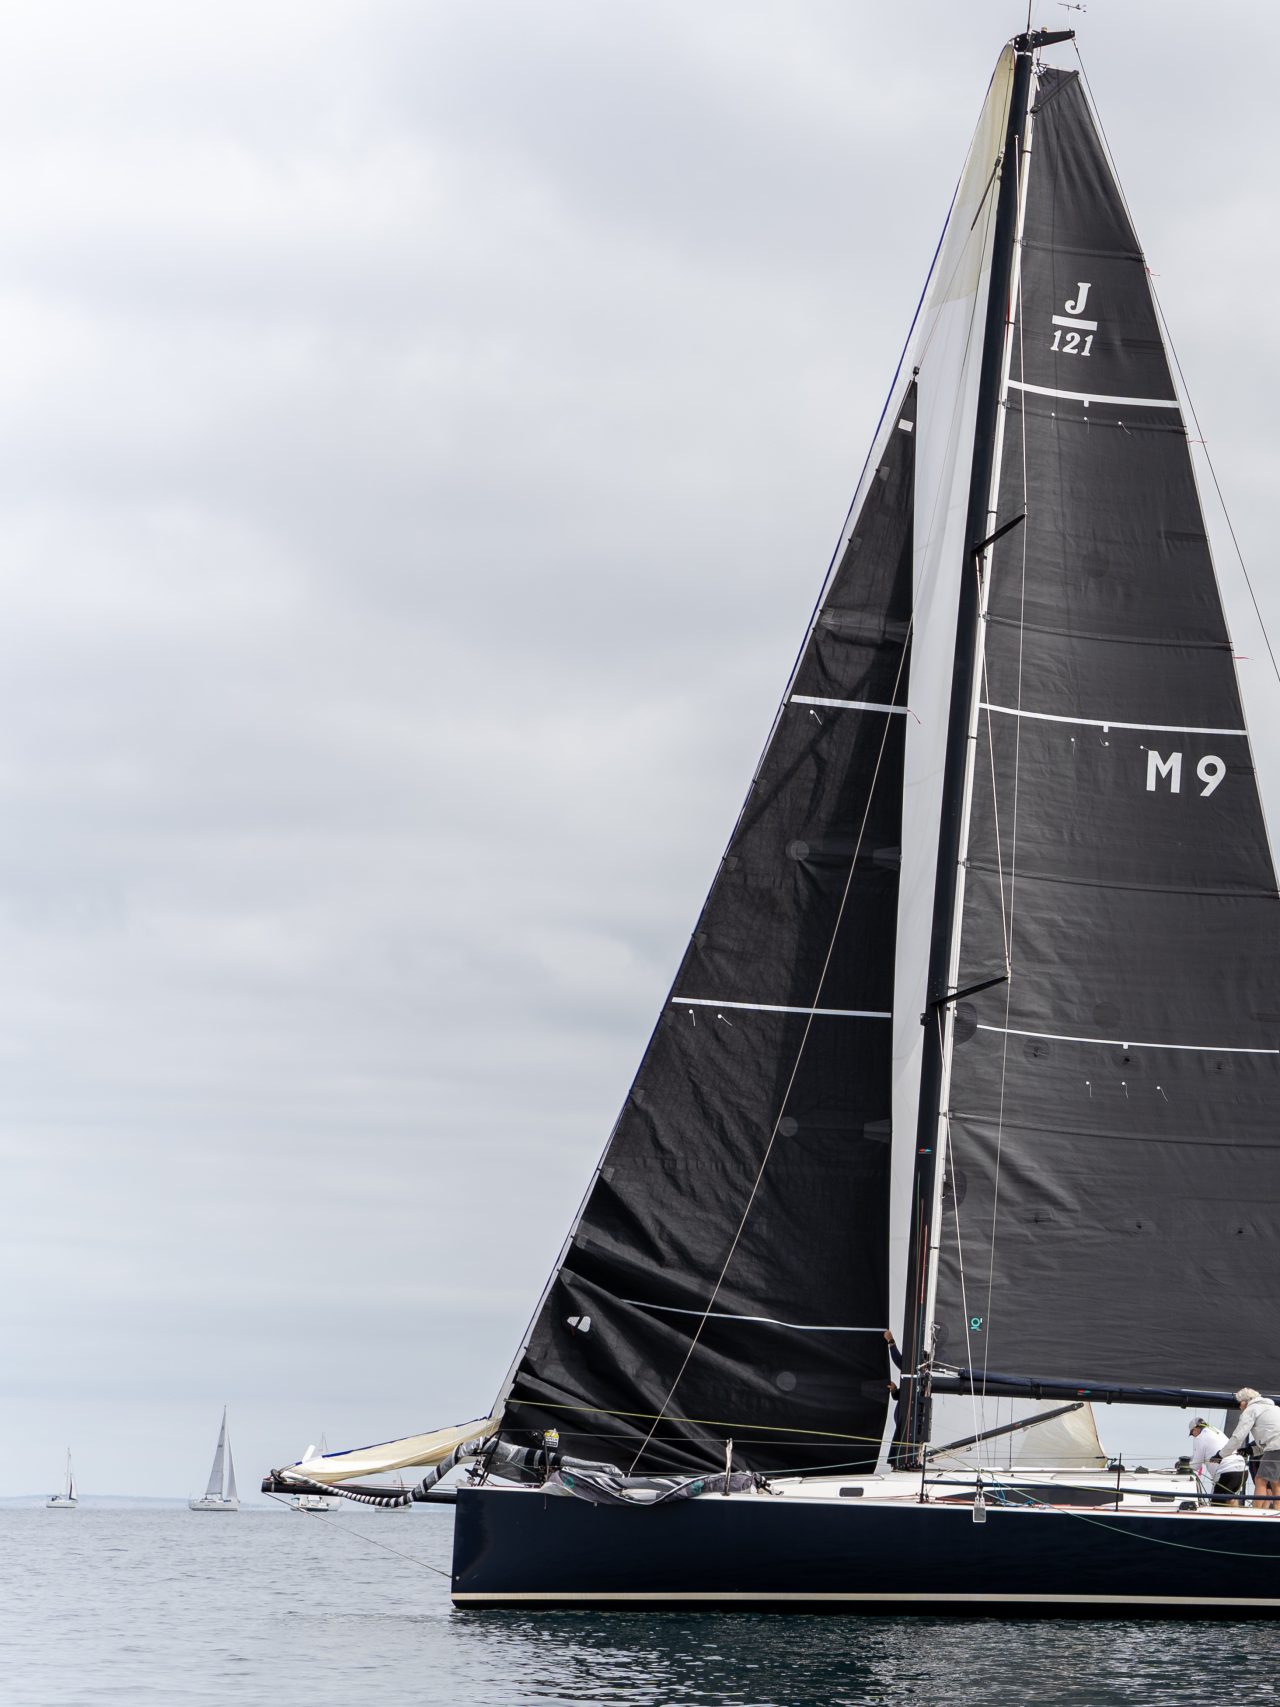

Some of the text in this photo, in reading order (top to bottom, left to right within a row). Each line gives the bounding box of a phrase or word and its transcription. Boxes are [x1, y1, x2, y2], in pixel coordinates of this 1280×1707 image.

[1064, 282, 1091, 315] J
[1050, 329, 1094, 357] 121
[1146, 750, 1227, 797] M 9
